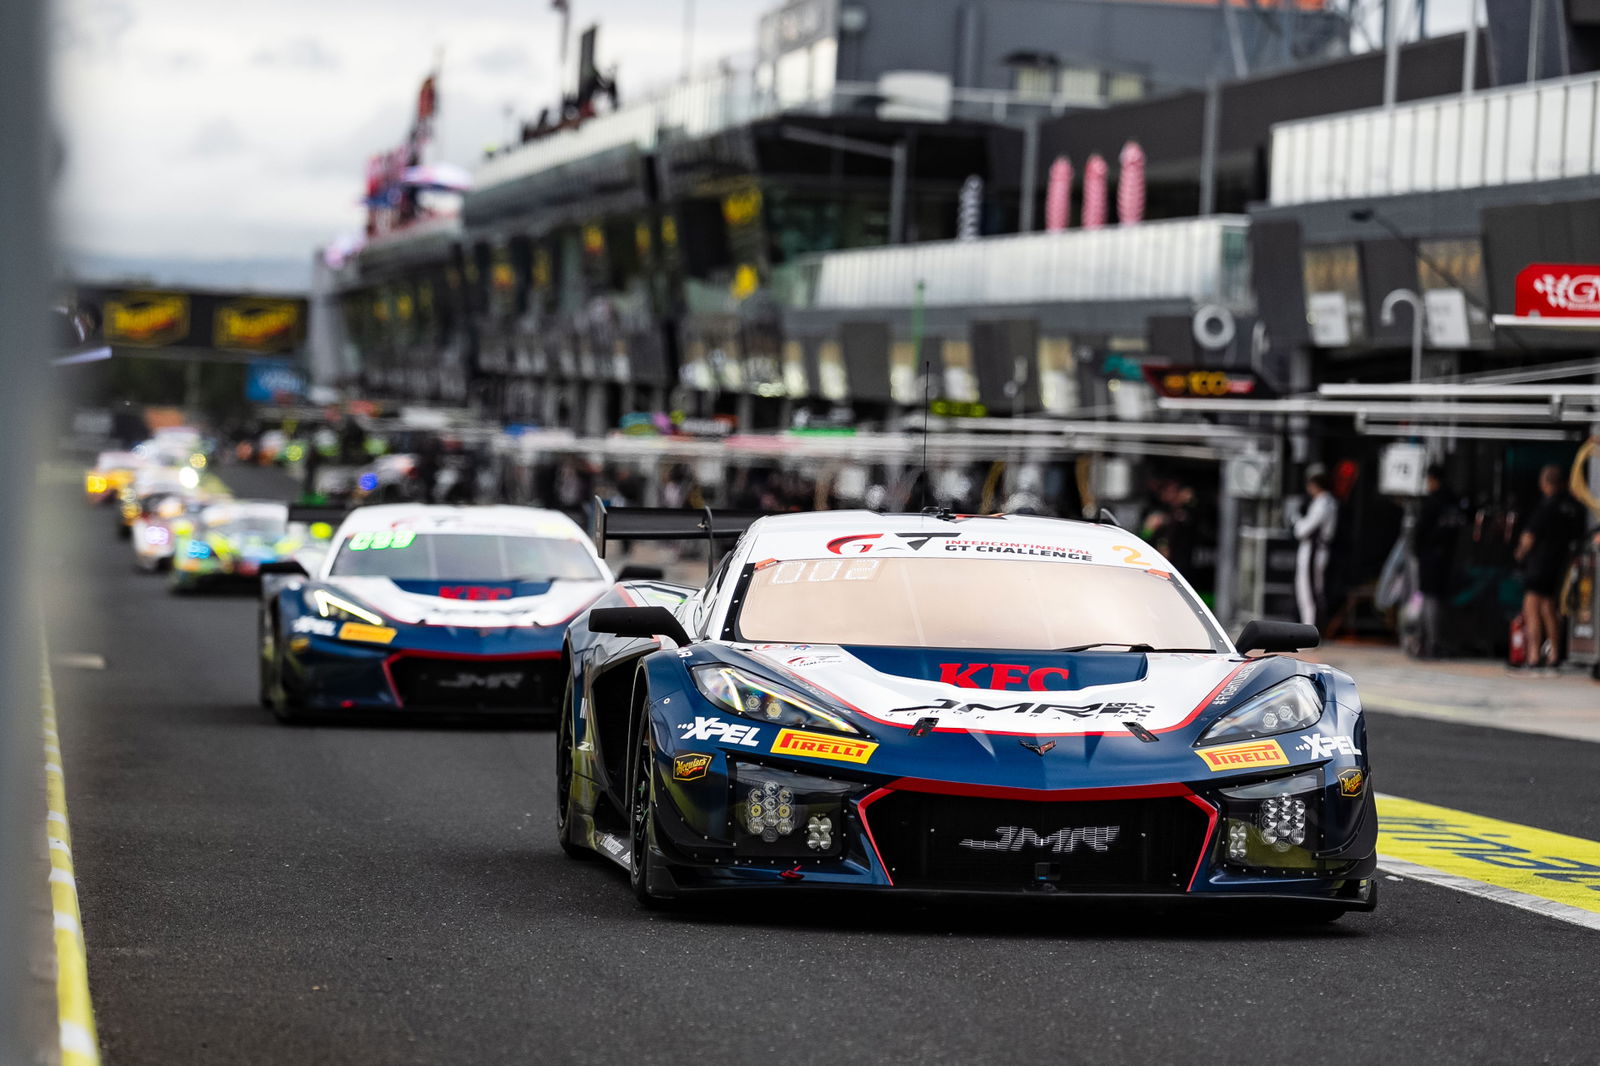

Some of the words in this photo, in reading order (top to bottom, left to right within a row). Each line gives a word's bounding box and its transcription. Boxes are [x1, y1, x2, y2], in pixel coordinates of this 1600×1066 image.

[945, 539, 1091, 555] INTERCONTINENTAL
[945, 544, 971, 552] GT
[976, 545, 1093, 562] CHALLENGE
[1112, 545, 1152, 566] 2
[772, 560, 880, 584] 002
[939, 663, 1070, 691] KFC
[680, 716, 760, 747] XPEL
[779, 732, 870, 758] PIRELLI
[1205, 744, 1281, 766] PIRELLI
[1300, 733, 1362, 760] XPEL
[958, 825, 1120, 852] JMR
